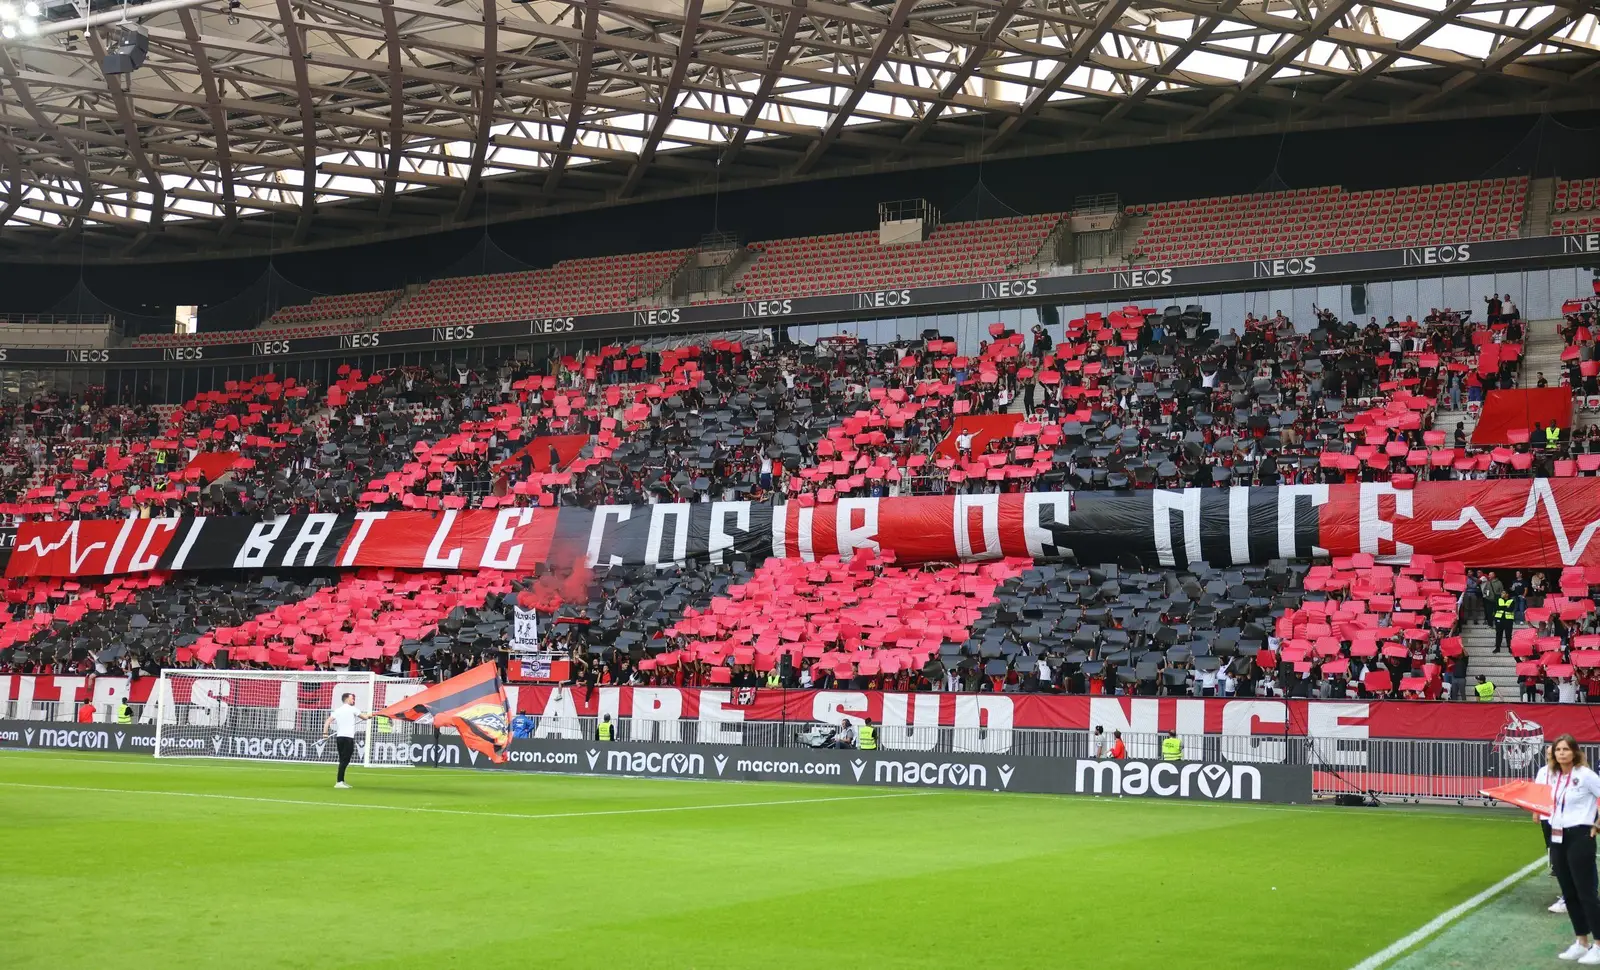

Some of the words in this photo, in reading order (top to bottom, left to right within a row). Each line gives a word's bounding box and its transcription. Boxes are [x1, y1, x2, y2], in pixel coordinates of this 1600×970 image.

[1403, 244, 1470, 266] INEOS
[1253, 257, 1317, 278] INEOS
[1113, 268, 1173, 289] INEOS
[858, 289, 911, 309] INEOS
[981, 279, 1038, 299] INEOS
[633, 308, 680, 326] INEOS
[743, 299, 792, 317] INEOS
[432, 325, 474, 341] INEOS
[530, 317, 574, 334] INEOS
[252, 340, 290, 355] INEOS
[340, 333, 380, 348] INEOS
[66, 350, 109, 362] INEOS
[163, 346, 202, 360] INEOS
[104, 516, 206, 574] ICI
[233, 511, 387, 567] BAT
[424, 507, 533, 569] LE
[587, 496, 880, 569] COEUR
[954, 490, 1074, 563] DE
[1153, 482, 1414, 567] NICE
[39, 729, 108, 749] macron
[813, 691, 1013, 754] SUD
[1090, 697, 1369, 768] NICE
[131, 736, 205, 749] macon.com
[229, 736, 306, 758] macron
[374, 741, 460, 765] macron
[607, 750, 704, 775] macron
[737, 760, 840, 775] macron.com
[875, 761, 986, 787] macron
[1075, 759, 1262, 801] macron
